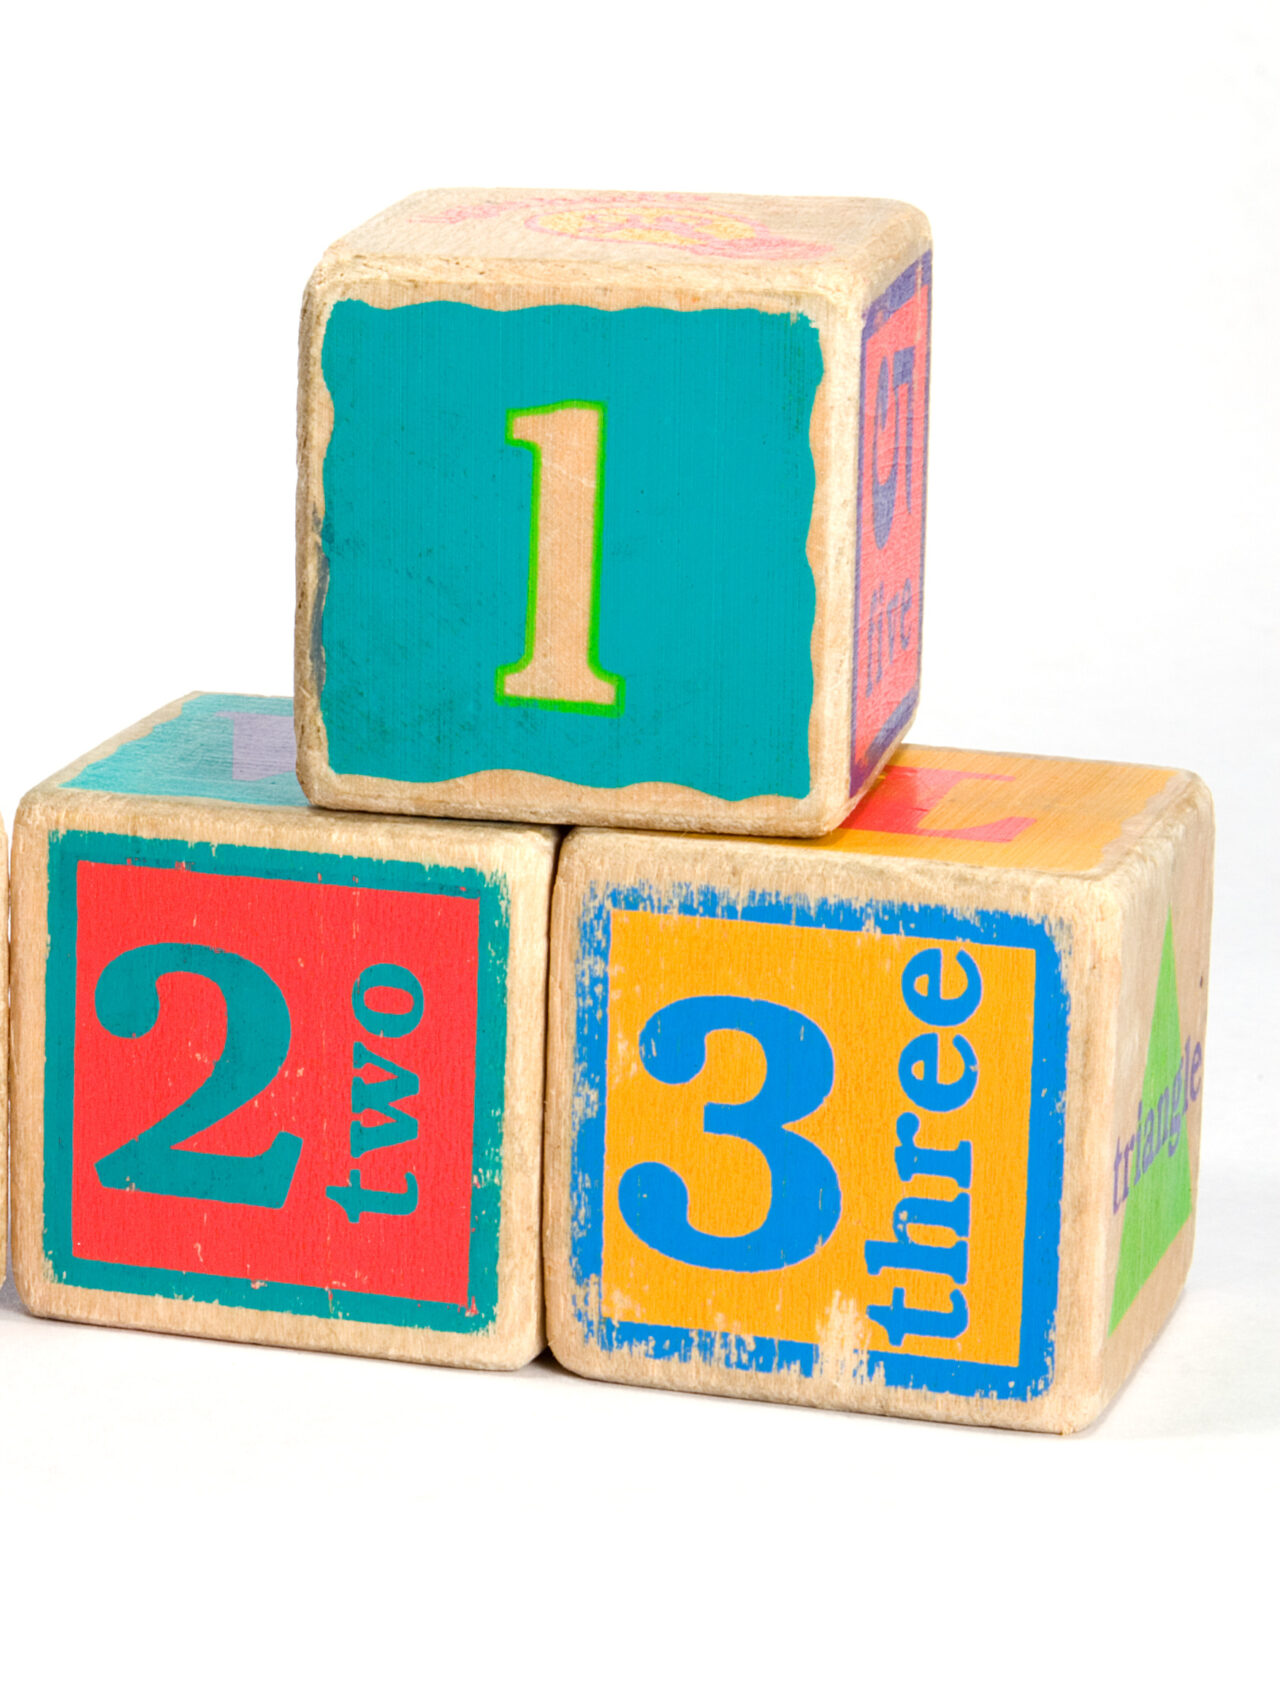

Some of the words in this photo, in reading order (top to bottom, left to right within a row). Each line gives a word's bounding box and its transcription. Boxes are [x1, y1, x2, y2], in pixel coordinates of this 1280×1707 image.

[494, 399, 626, 718] 1
[871, 345, 916, 551] 5
[865, 577, 913, 699] five
[94, 942, 303, 1209] 2
[325, 963, 424, 1223] two
[618, 995, 842, 1273] 3
[863, 947, 983, 1347] three
[1113, 1035, 1202, 1215] triangle
